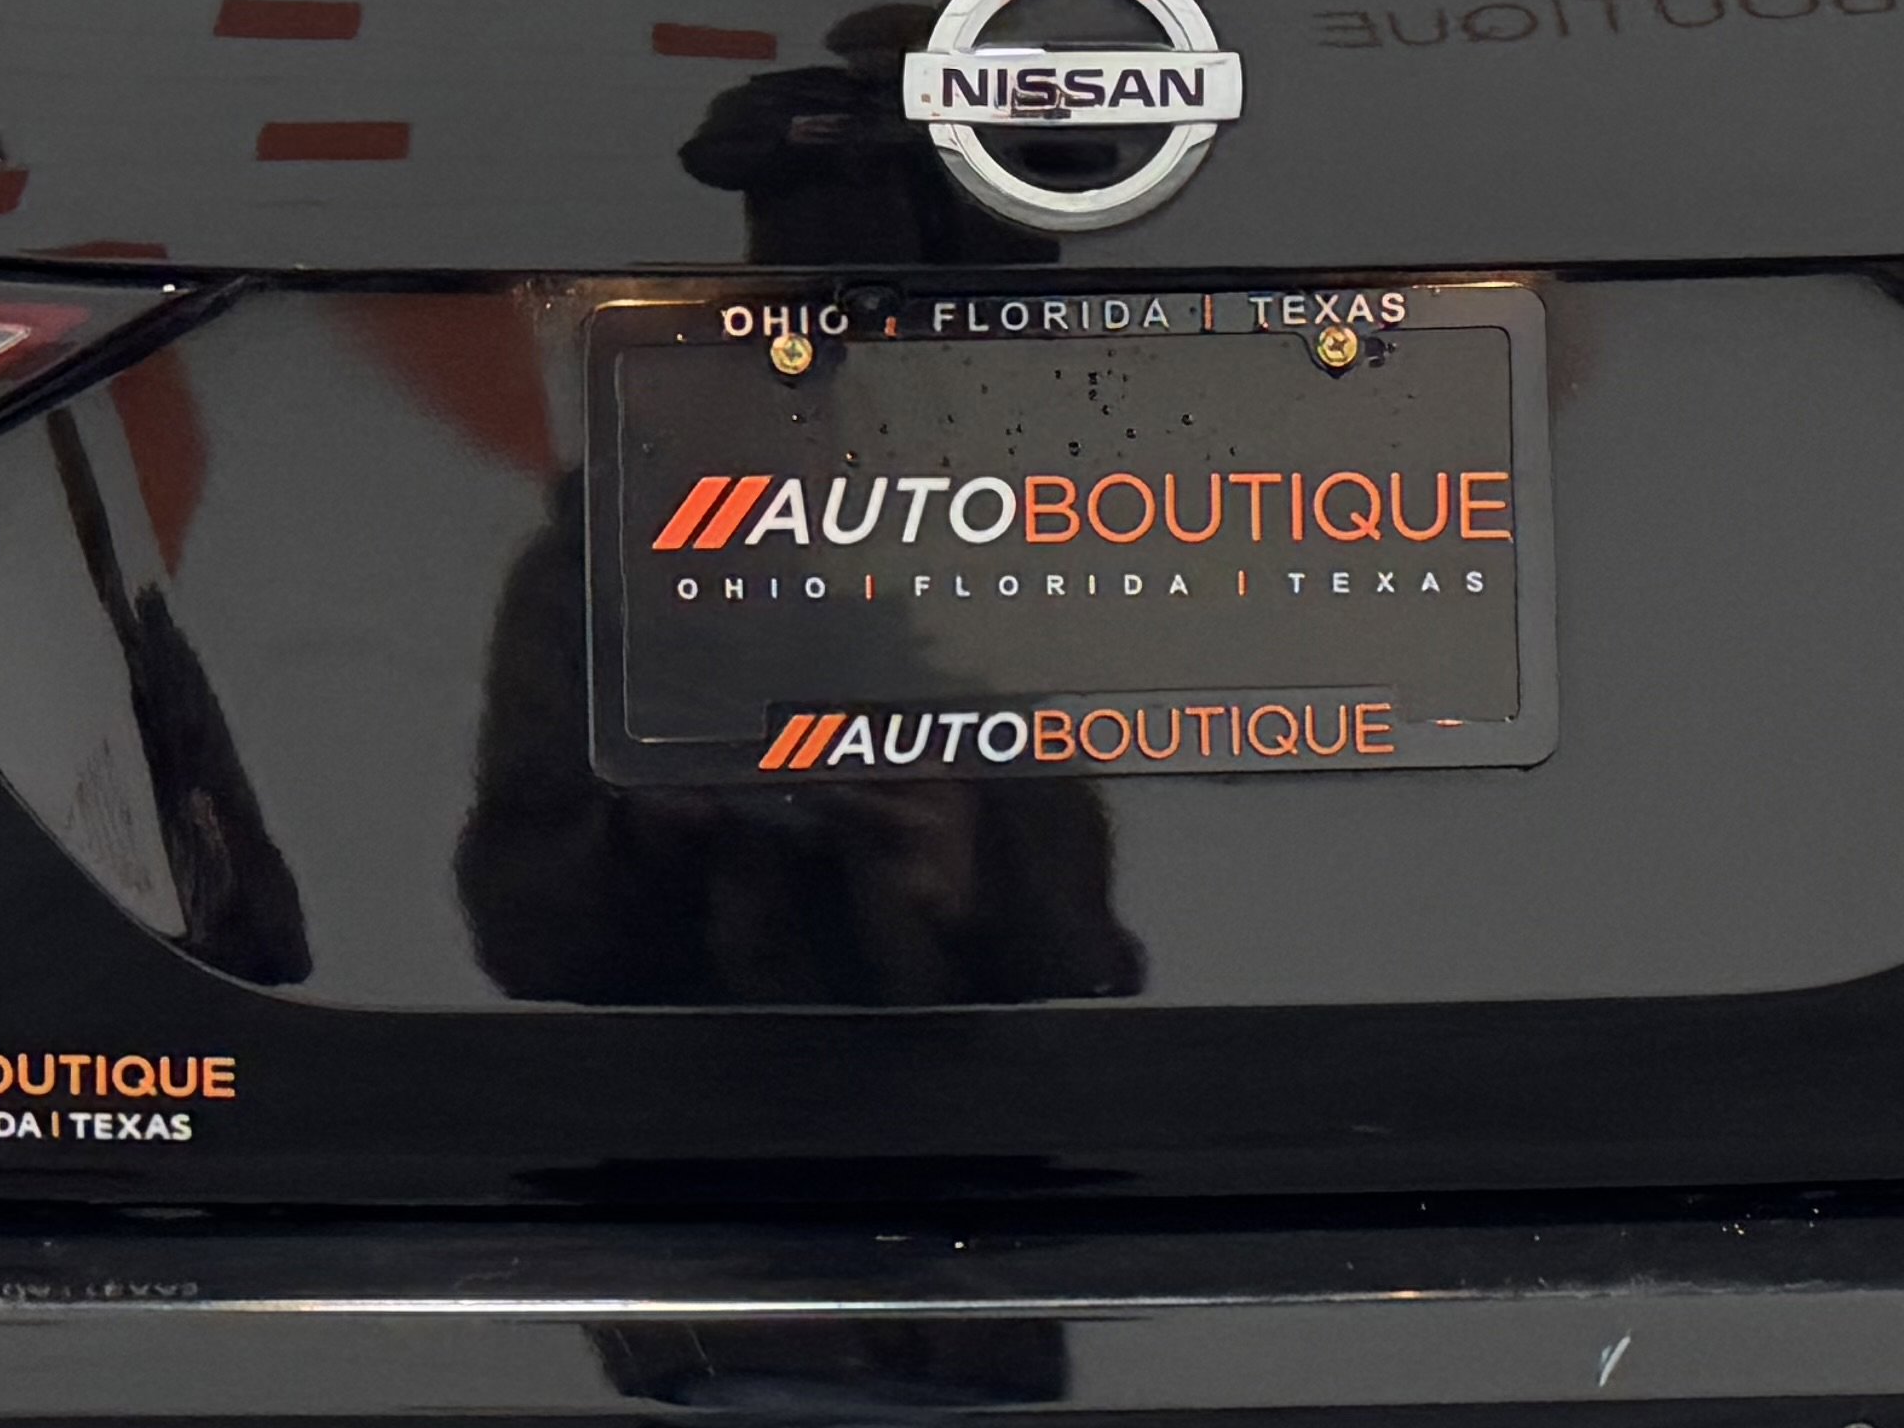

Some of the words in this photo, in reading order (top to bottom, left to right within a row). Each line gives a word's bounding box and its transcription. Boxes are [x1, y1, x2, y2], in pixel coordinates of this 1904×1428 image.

[941, 67, 1206, 109] NISSAN
[723, 304, 851, 339] OHIO
[932, 296, 1171, 333] FLORIDA
[1248, 291, 1408, 332] TEXAS
[744, 470, 1515, 547] AUTOBOUTIQUE
[676, 576, 827, 601] OHIO
[914, 572, 1189, 598] FLORIDA
[1288, 569, 1485, 595] TEXAS
[826, 700, 1395, 766] AUTOBOUTIQUE
[69, 1111, 193, 1142] TEXAS
